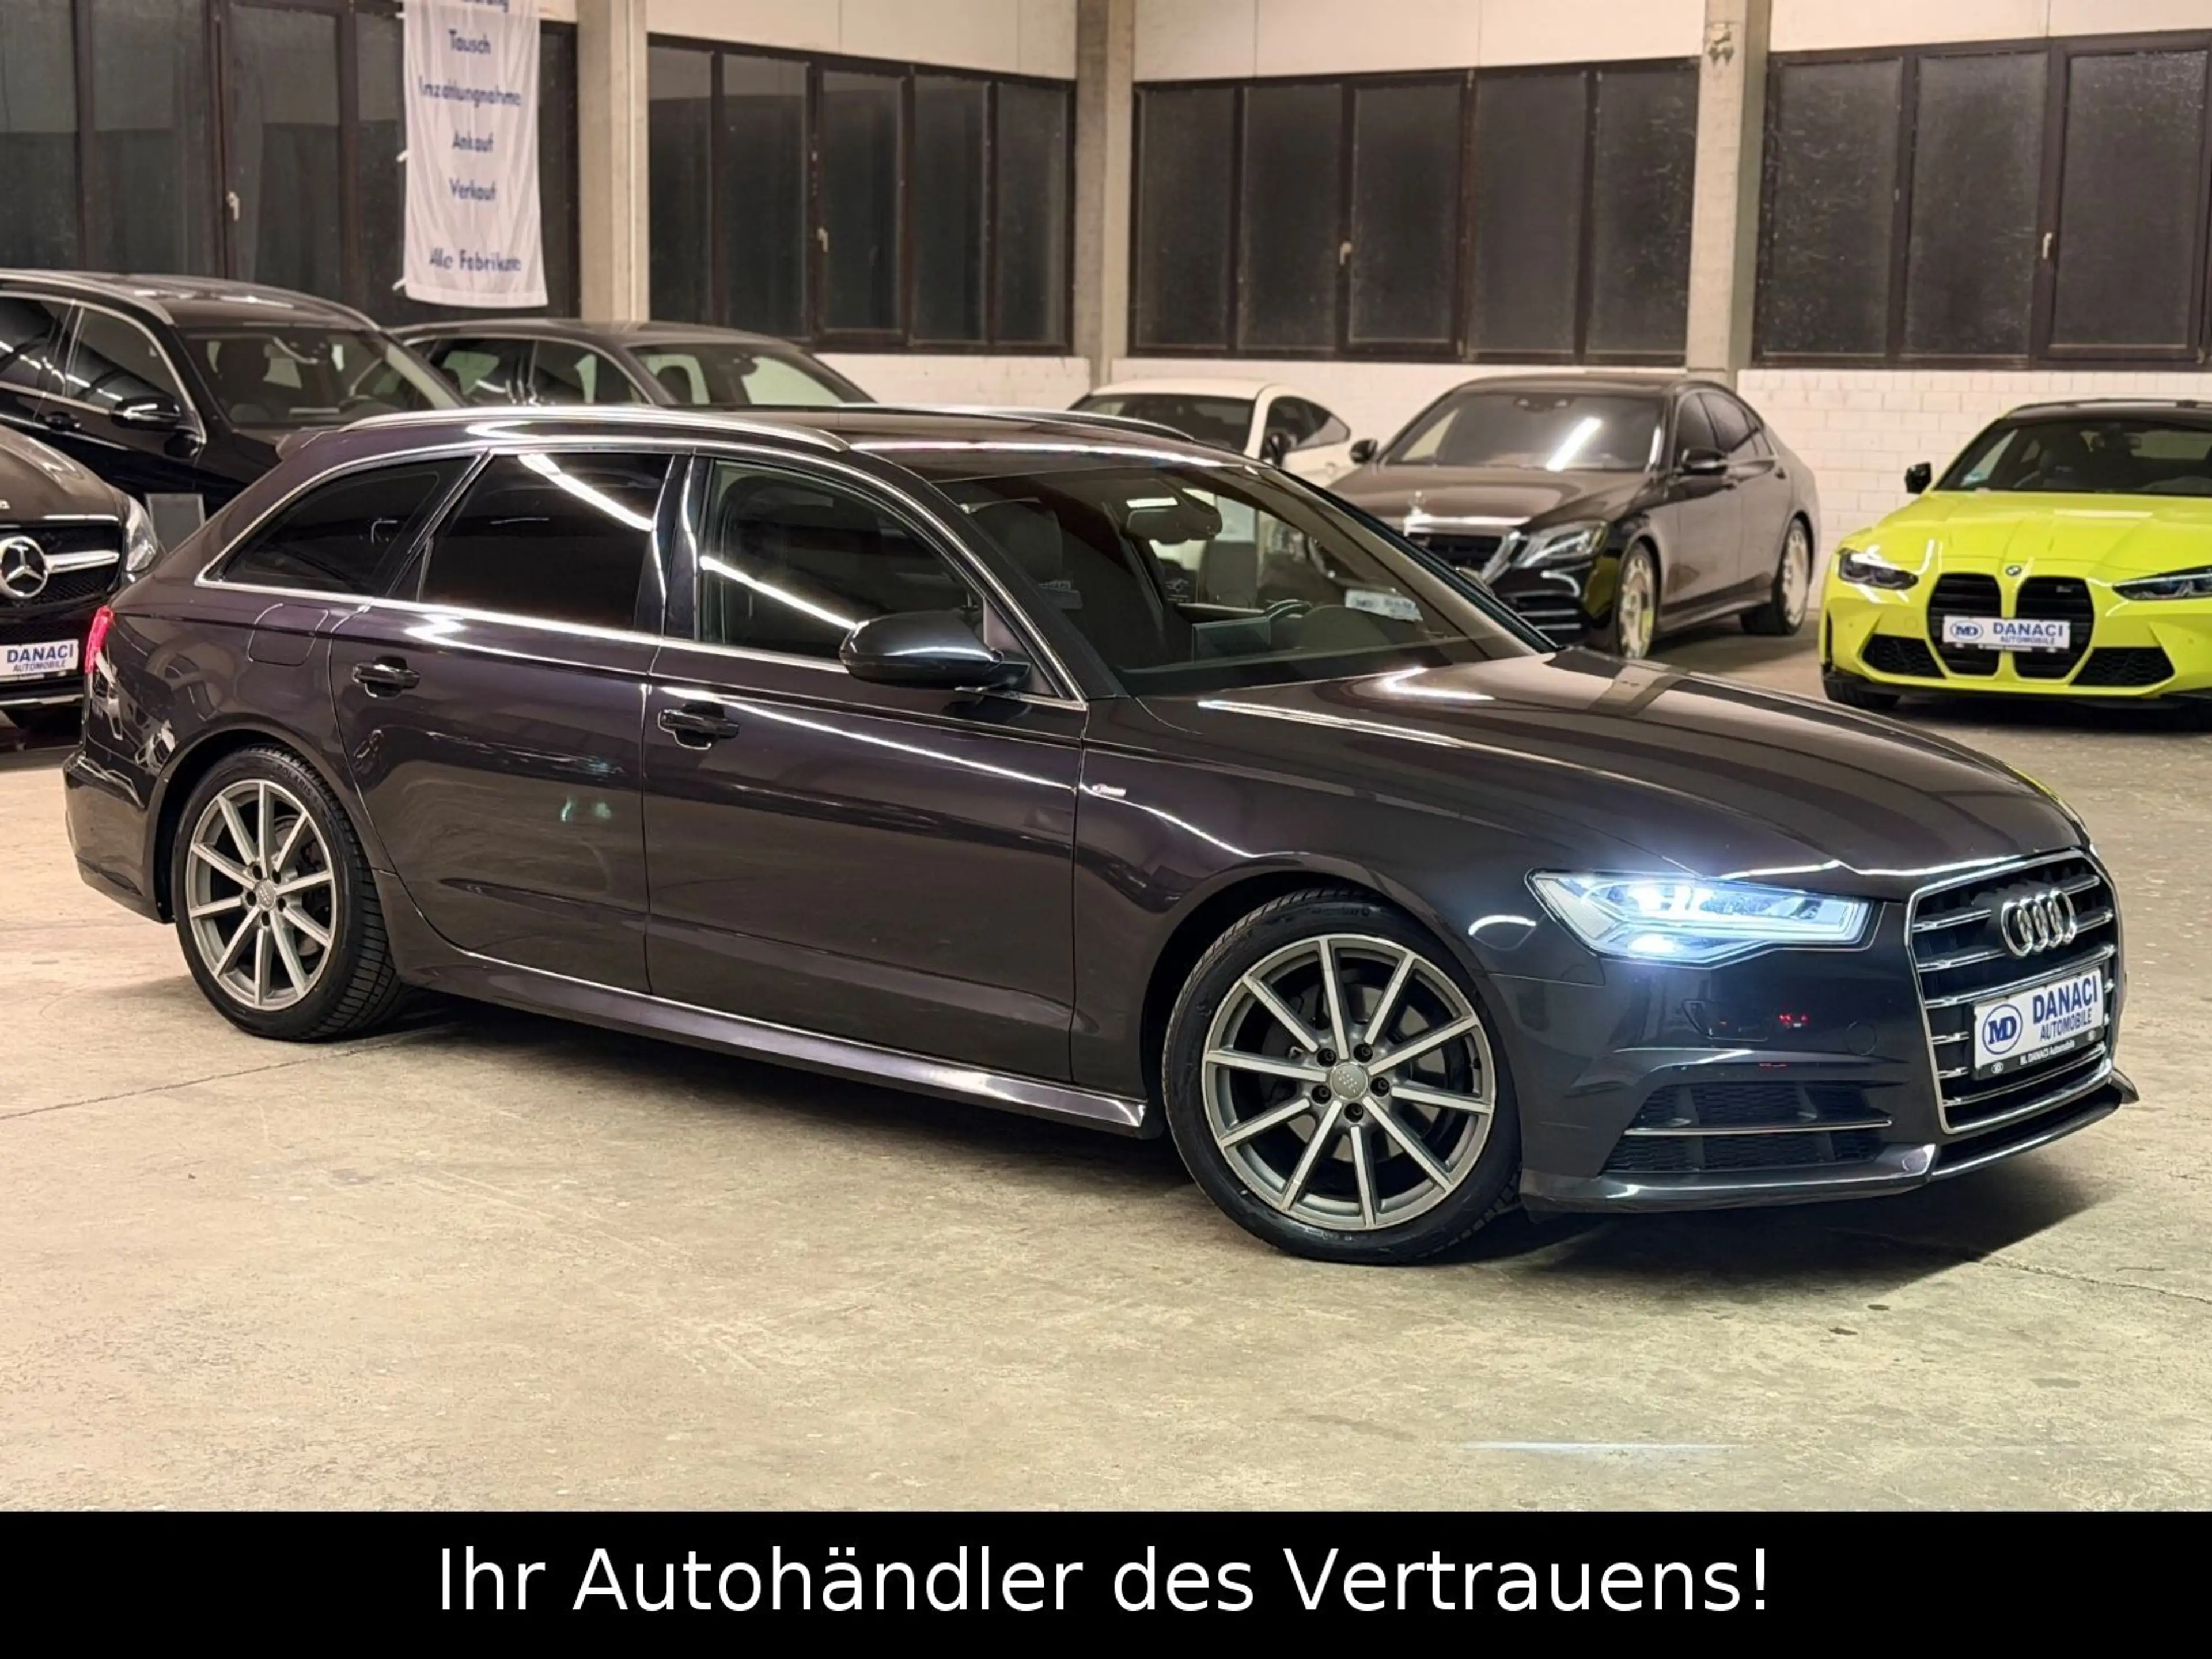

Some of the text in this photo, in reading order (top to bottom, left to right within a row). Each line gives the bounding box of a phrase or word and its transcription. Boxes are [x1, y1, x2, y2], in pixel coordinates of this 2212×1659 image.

[449, 29, 491, 54] Tausch
[452, 130, 494, 153] Ankauf
[449, 178, 497, 201] Verkauf
[1993, 622, 2063, 637] DANACI
[2000, 635, 2055, 645] AUTOMOBILE
[7, 644, 73, 663] DANACI
[13, 660, 66, 672] AUTOMOBILE
[2032, 975, 2097, 1024] DANACI
[2040, 1008, 2092, 1041] AUTOMOBILE
